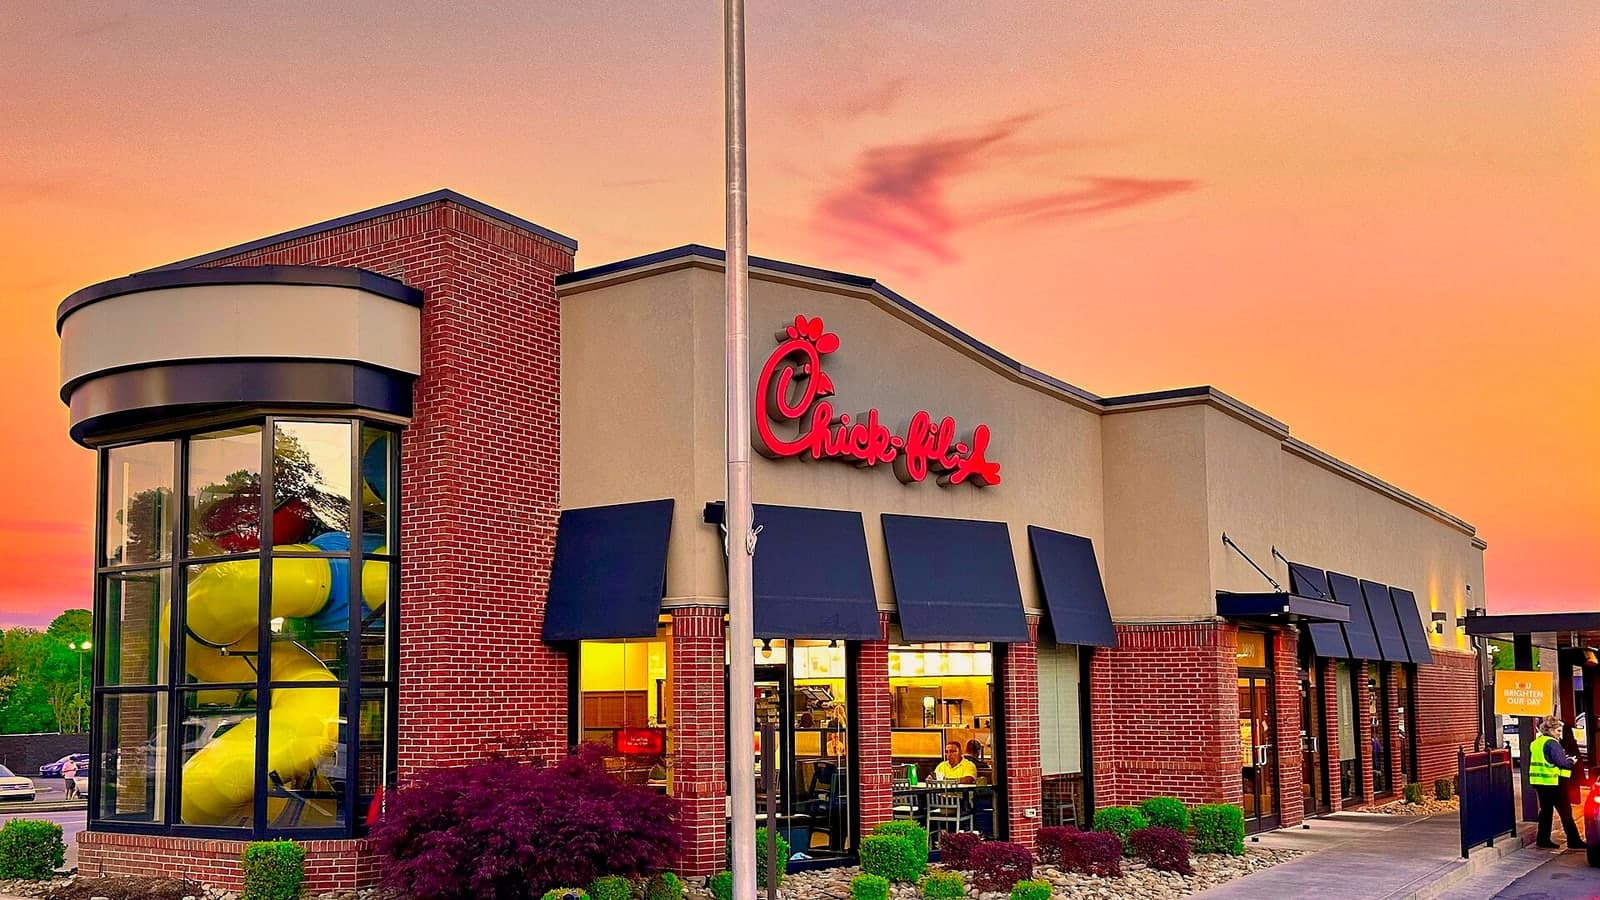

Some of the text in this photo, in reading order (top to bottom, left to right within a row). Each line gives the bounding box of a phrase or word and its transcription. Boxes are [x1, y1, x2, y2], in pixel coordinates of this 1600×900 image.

[755, 314, 1001, 486] Chick-fil-A
[1503, 688, 1544, 698] BRIGHTEN
[1507, 697, 1541, 706] OUR DAY
